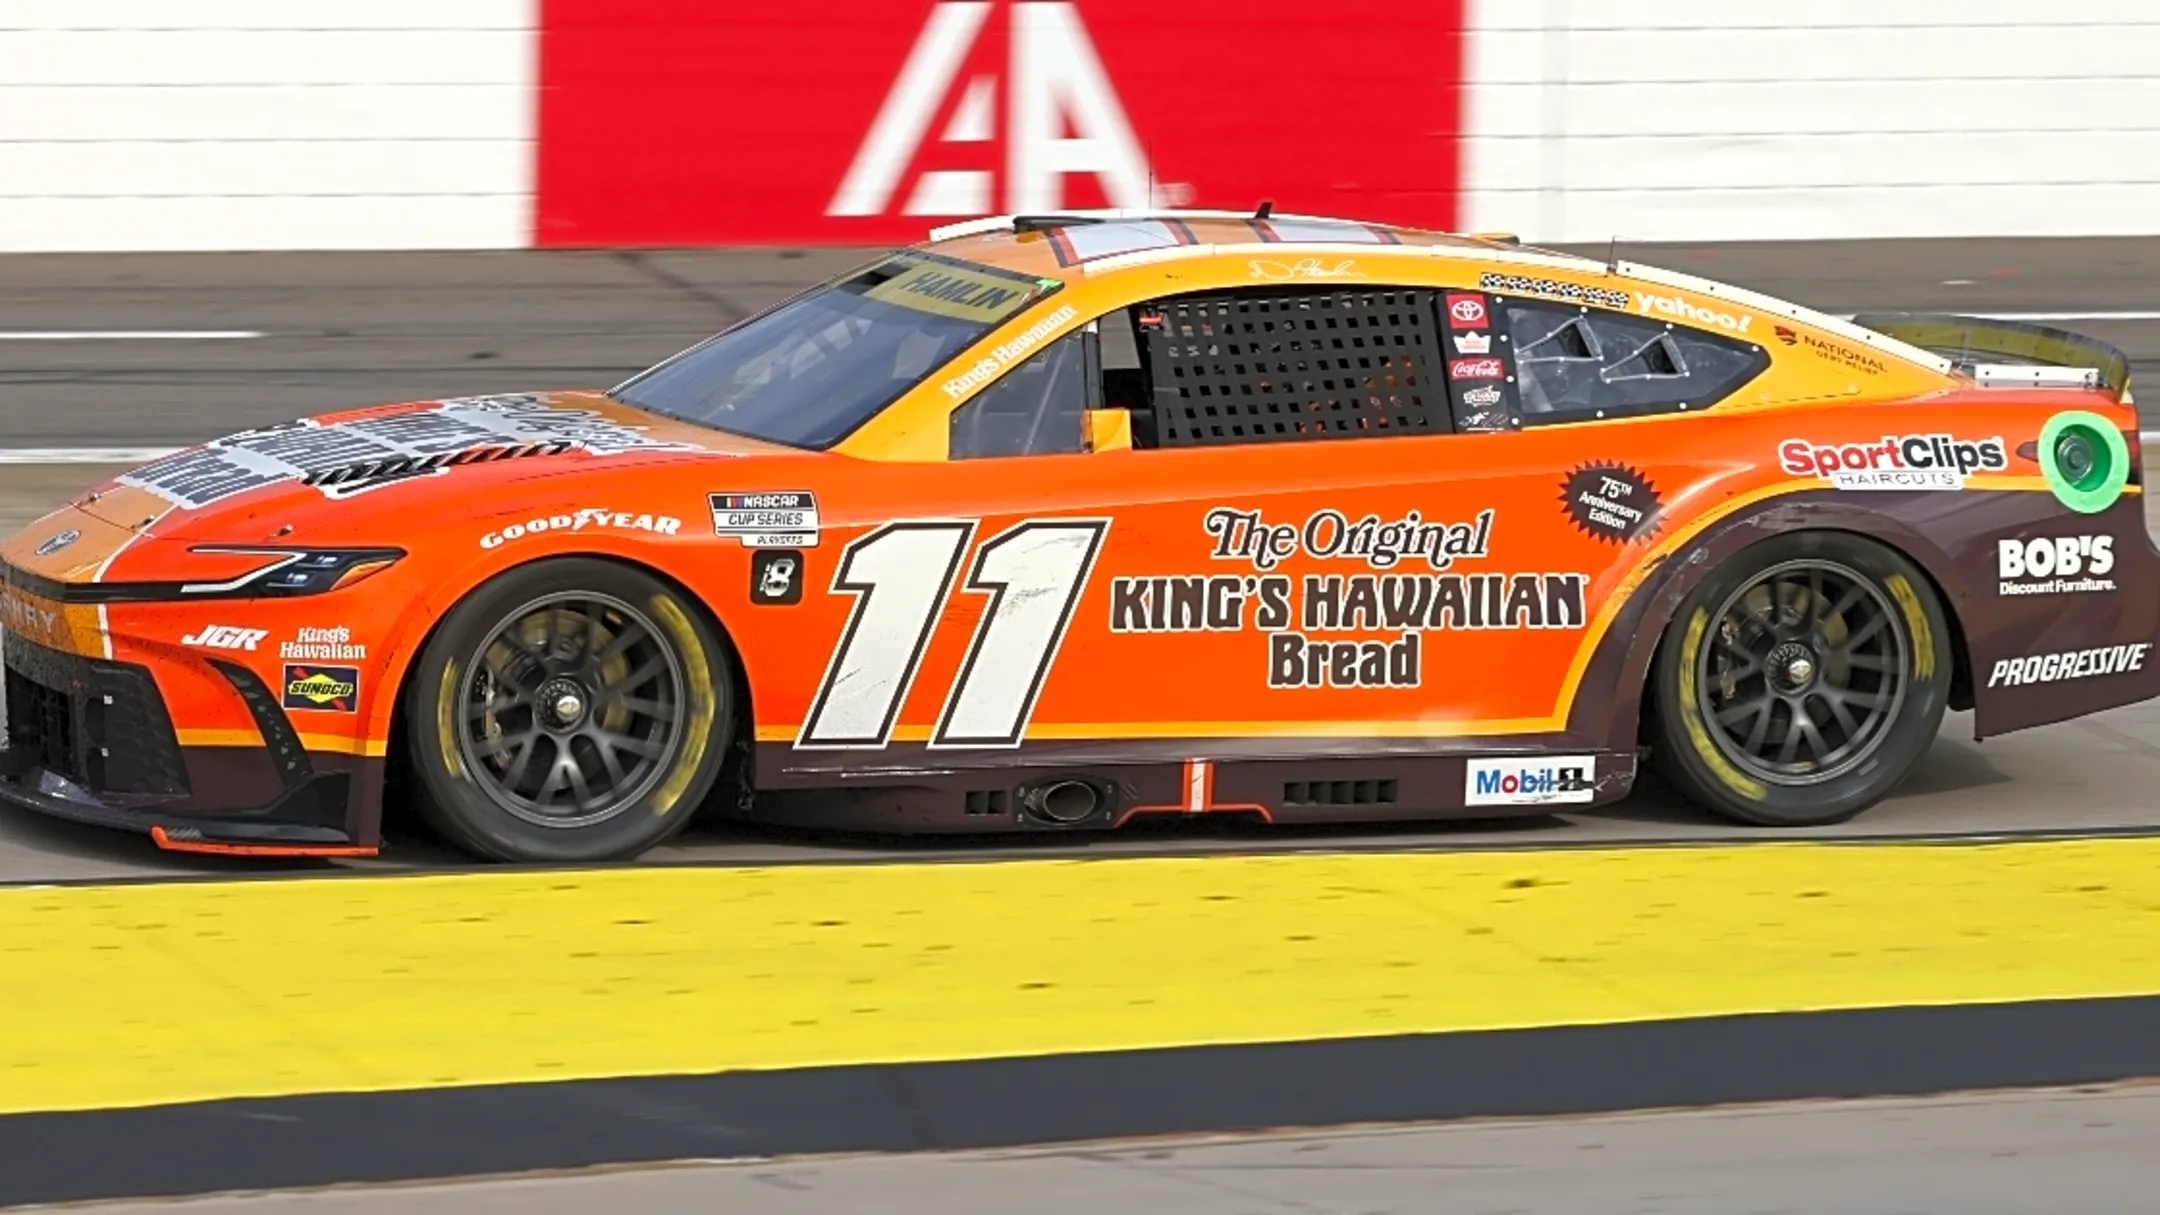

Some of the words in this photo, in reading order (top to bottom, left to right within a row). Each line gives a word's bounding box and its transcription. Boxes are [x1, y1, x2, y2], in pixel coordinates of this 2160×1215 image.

[898, 271, 1019, 310] HAMLIN
[1633, 290, 1752, 332] yahoo!
[941, 357, 1000, 399] King's
[991, 304, 1079, 365] Hawaiian
[1804, 335, 1888, 373] NATIONAL
[1840, 473, 1954, 485] HAIRCUTS
[728, 513, 755, 525] CUP
[757, 512, 803, 525] SERIES
[744, 495, 799, 508] NASCAR
[1579, 491, 1643, 523] Anniversary
[1588, 507, 1627, 530] Edition
[479, 508, 682, 550] GOODYEAR
[1205, 509, 1297, 569] The
[1303, 509, 1495, 569] Original
[1999, 535, 2114, 578] BOB'S
[1110, 575, 1291, 632] KING'S
[1303, 574, 1586, 631] HAWAIIAN
[2000, 580, 2053, 595] Discount
[2055, 578, 2117, 593] Furniture.
[181, 625, 269, 650] JGR
[280, 642, 366, 659] Hawaiian
[297, 626, 350, 643] King's
[794, 517, 1113, 750] 11
[1268, 632, 1420, 687] Bread
[1987, 644, 2148, 688] PROGRESSIVE
[291, 682, 351, 695] SUNOCO
[1476, 769, 1552, 794] Mobil
